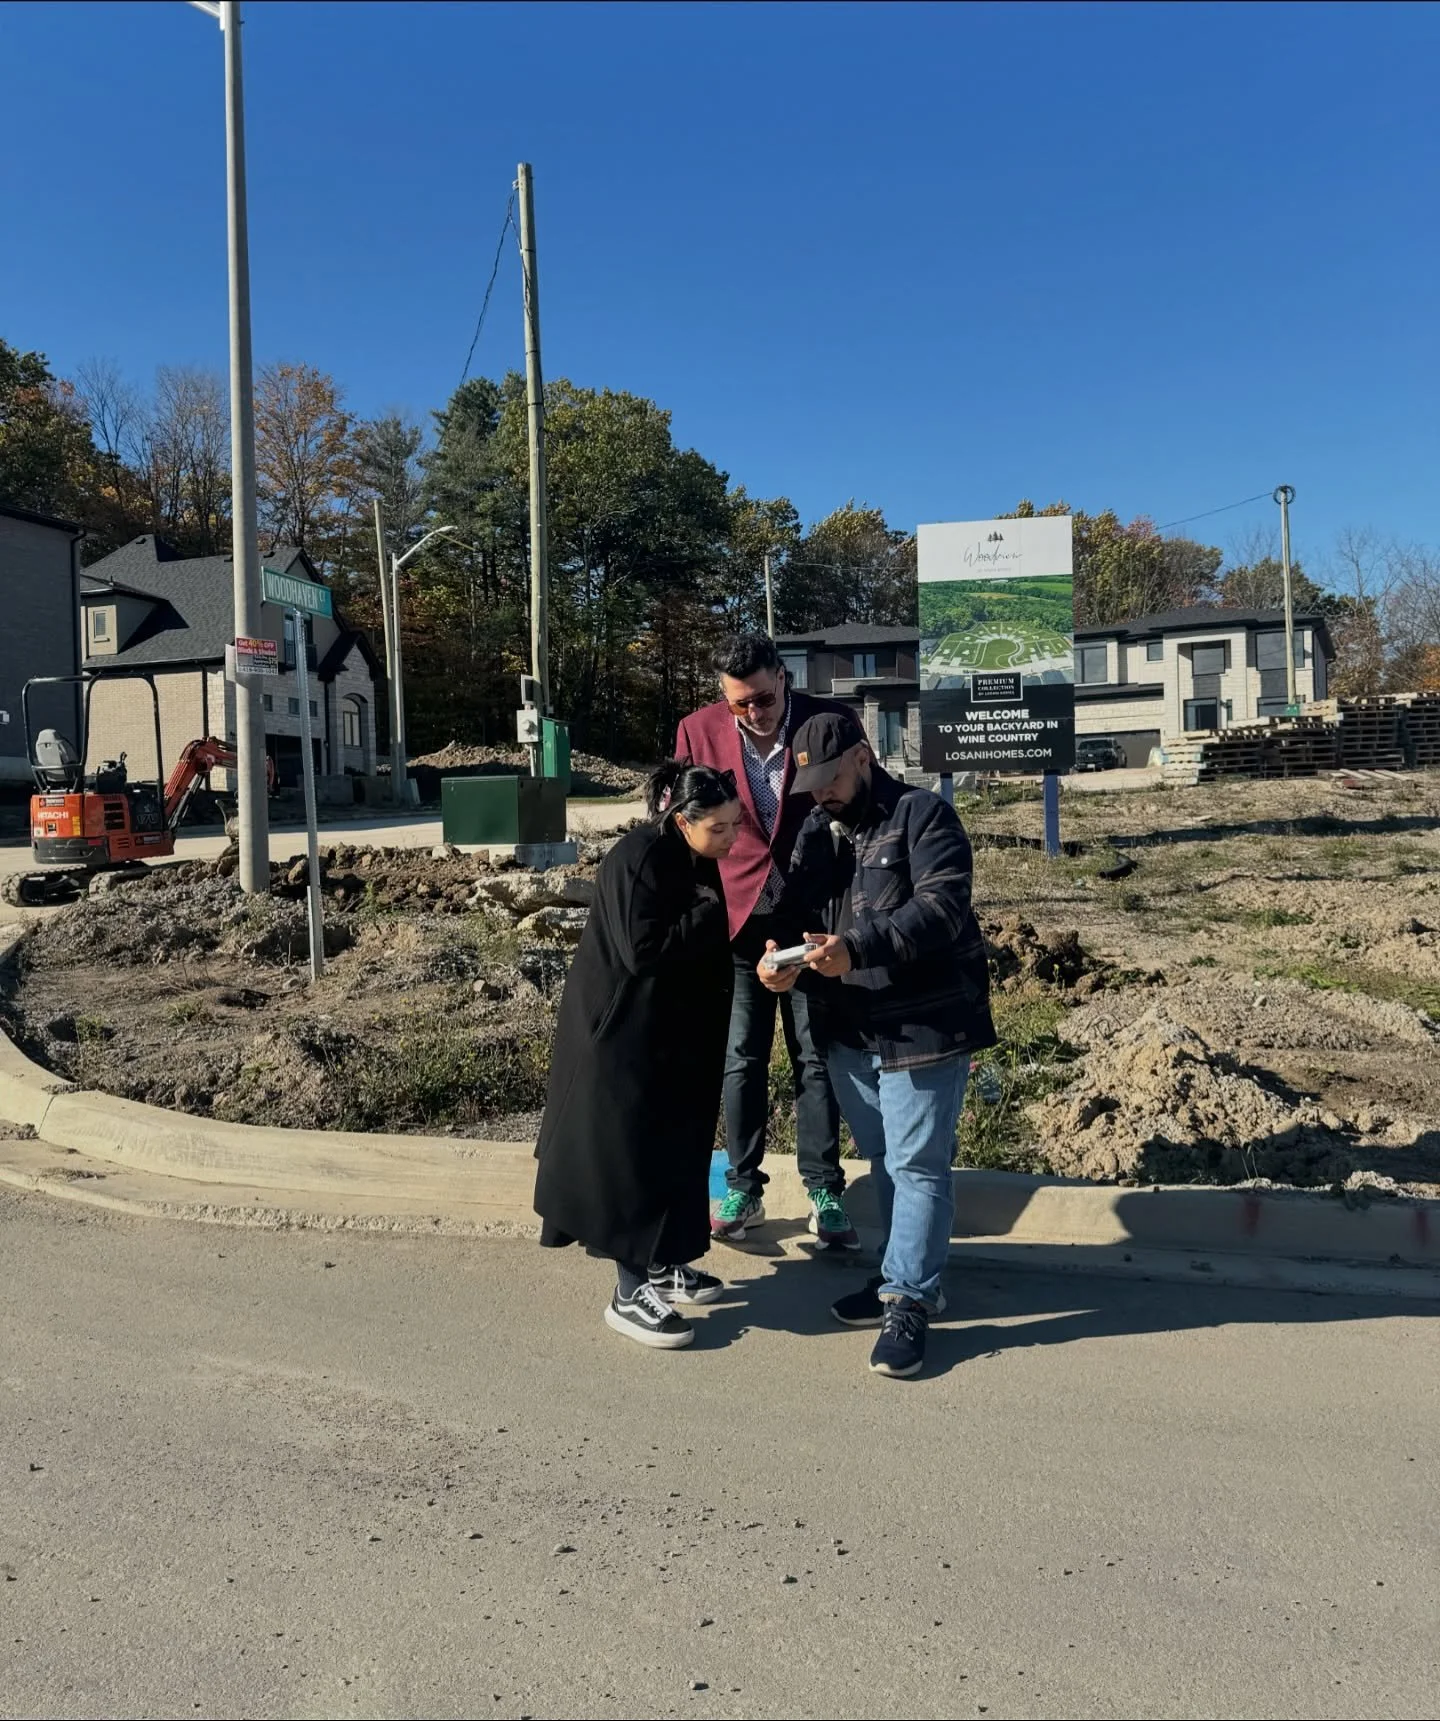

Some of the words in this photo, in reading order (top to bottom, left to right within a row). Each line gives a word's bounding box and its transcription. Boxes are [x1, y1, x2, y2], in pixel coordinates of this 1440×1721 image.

[266, 572, 318, 610] WOODHAVEN
[319, 589, 326, 603] CT
[248, 639, 263, 649] 40%
[977, 678, 1014, 686] PREMIUM
[965, 709, 1030, 721] WELCOME
[938, 725, 953, 733] TO
[955, 723, 984, 733] YOUR
[986, 721, 1044, 731] BACKYARD
[1046, 720, 1058, 729] IN
[957, 735, 986, 744] WINE
[988, 733, 1039, 743] COUNTRY
[945, 748, 1052, 760] LOSANIHOMES.COM
[37, 811, 69, 819] HITACHI
